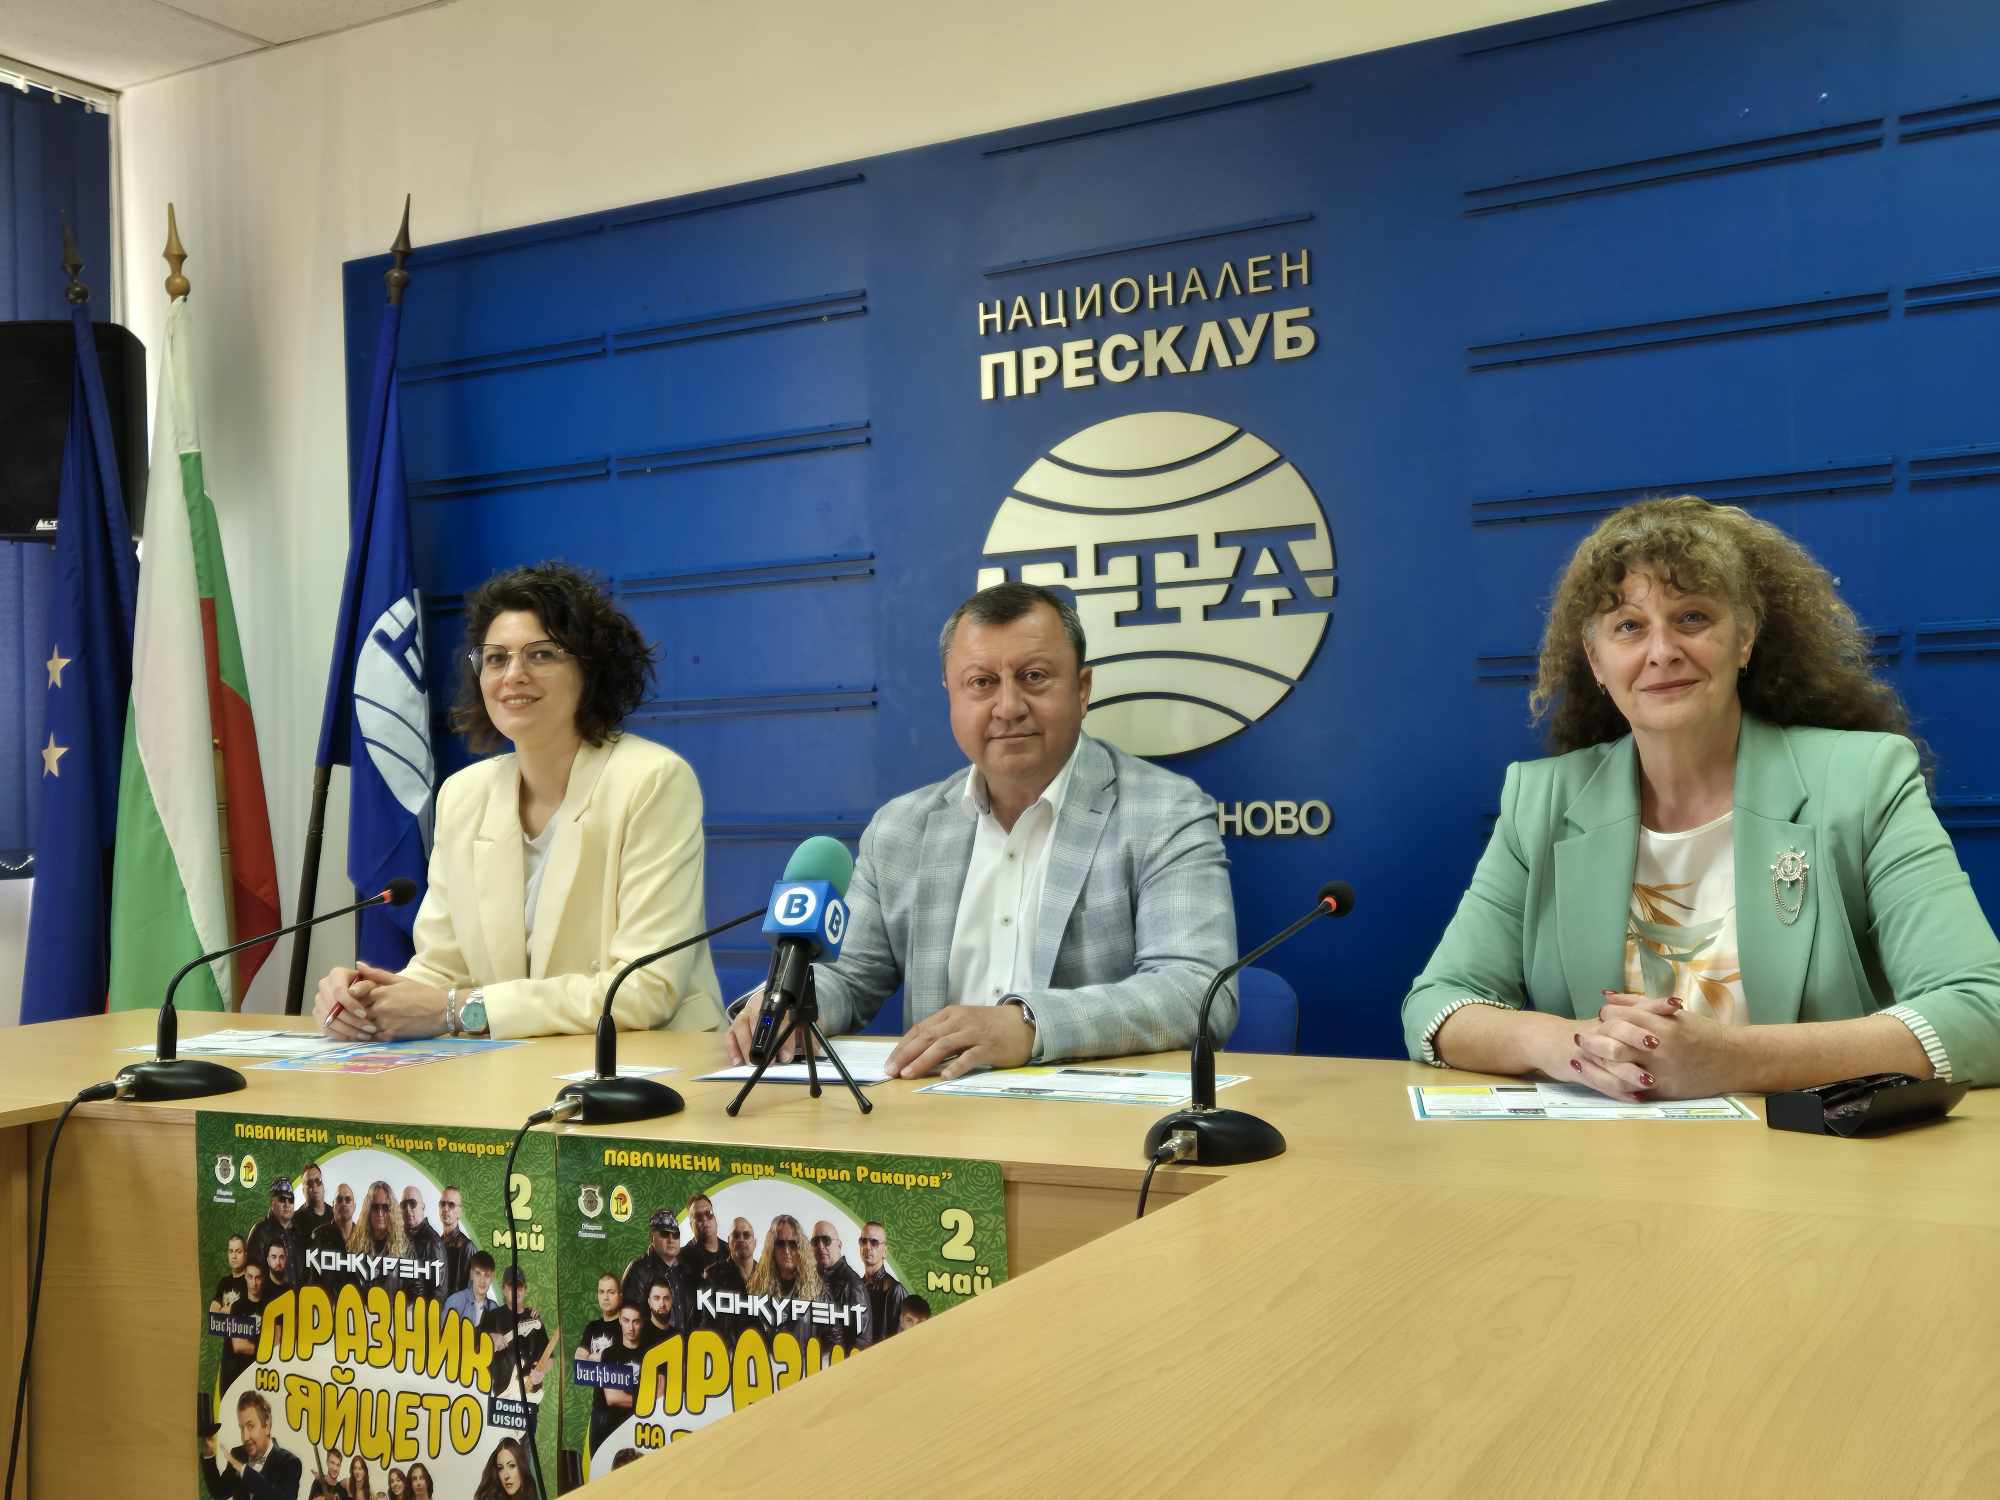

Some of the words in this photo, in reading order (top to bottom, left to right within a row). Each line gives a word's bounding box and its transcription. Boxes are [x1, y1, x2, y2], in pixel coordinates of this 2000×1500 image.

[978, 248, 1311, 336] НАЦИОНАЛЕН
[980, 306, 1317, 400] ПРЕСКЛУБ
[234, 1123, 329, 1144] ПАВЛИКЕНИ
[336, 1134, 373, 1150] парк
[604, 1149, 721, 1173] ПАВЛИКЕНИ
[731, 1162, 776, 1180] парк
[506, 1173, 533, 1220] 2
[940, 1208, 976, 1261] 2
[305, 1247, 445, 1288] КОНКУРЕНТ
[696, 1287, 867, 1336] КОНКУРЕНТ
[255, 1283, 494, 1393] ПРАЗНИК
[284, 1365, 484, 1471] ЯЙЦЕТО
[495, 1399, 532, 1415] Doub
